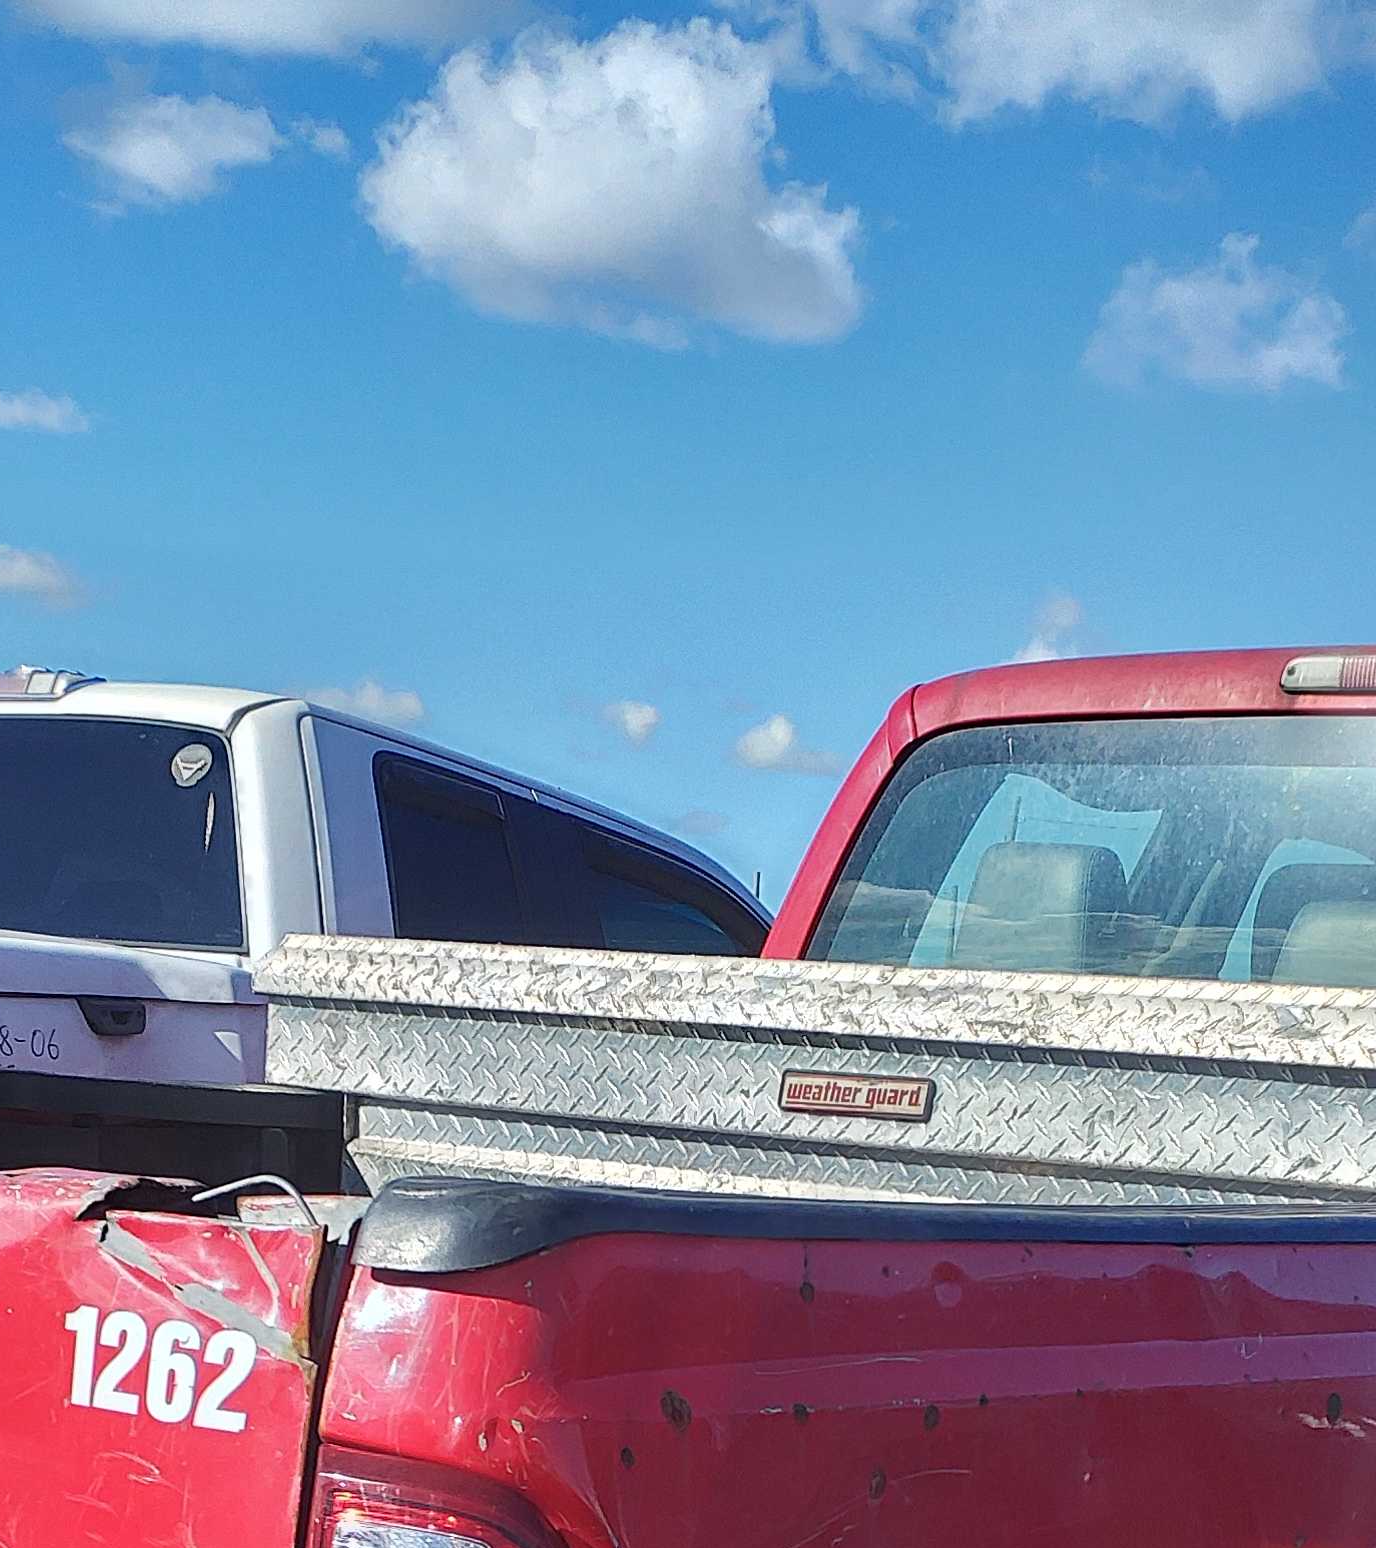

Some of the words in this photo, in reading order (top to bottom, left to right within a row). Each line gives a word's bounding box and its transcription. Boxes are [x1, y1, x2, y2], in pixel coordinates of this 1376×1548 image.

[786, 1080, 862, 1104] weather
[865, 1086, 922, 1108] guard
[64, 1304, 258, 1433] 1262
